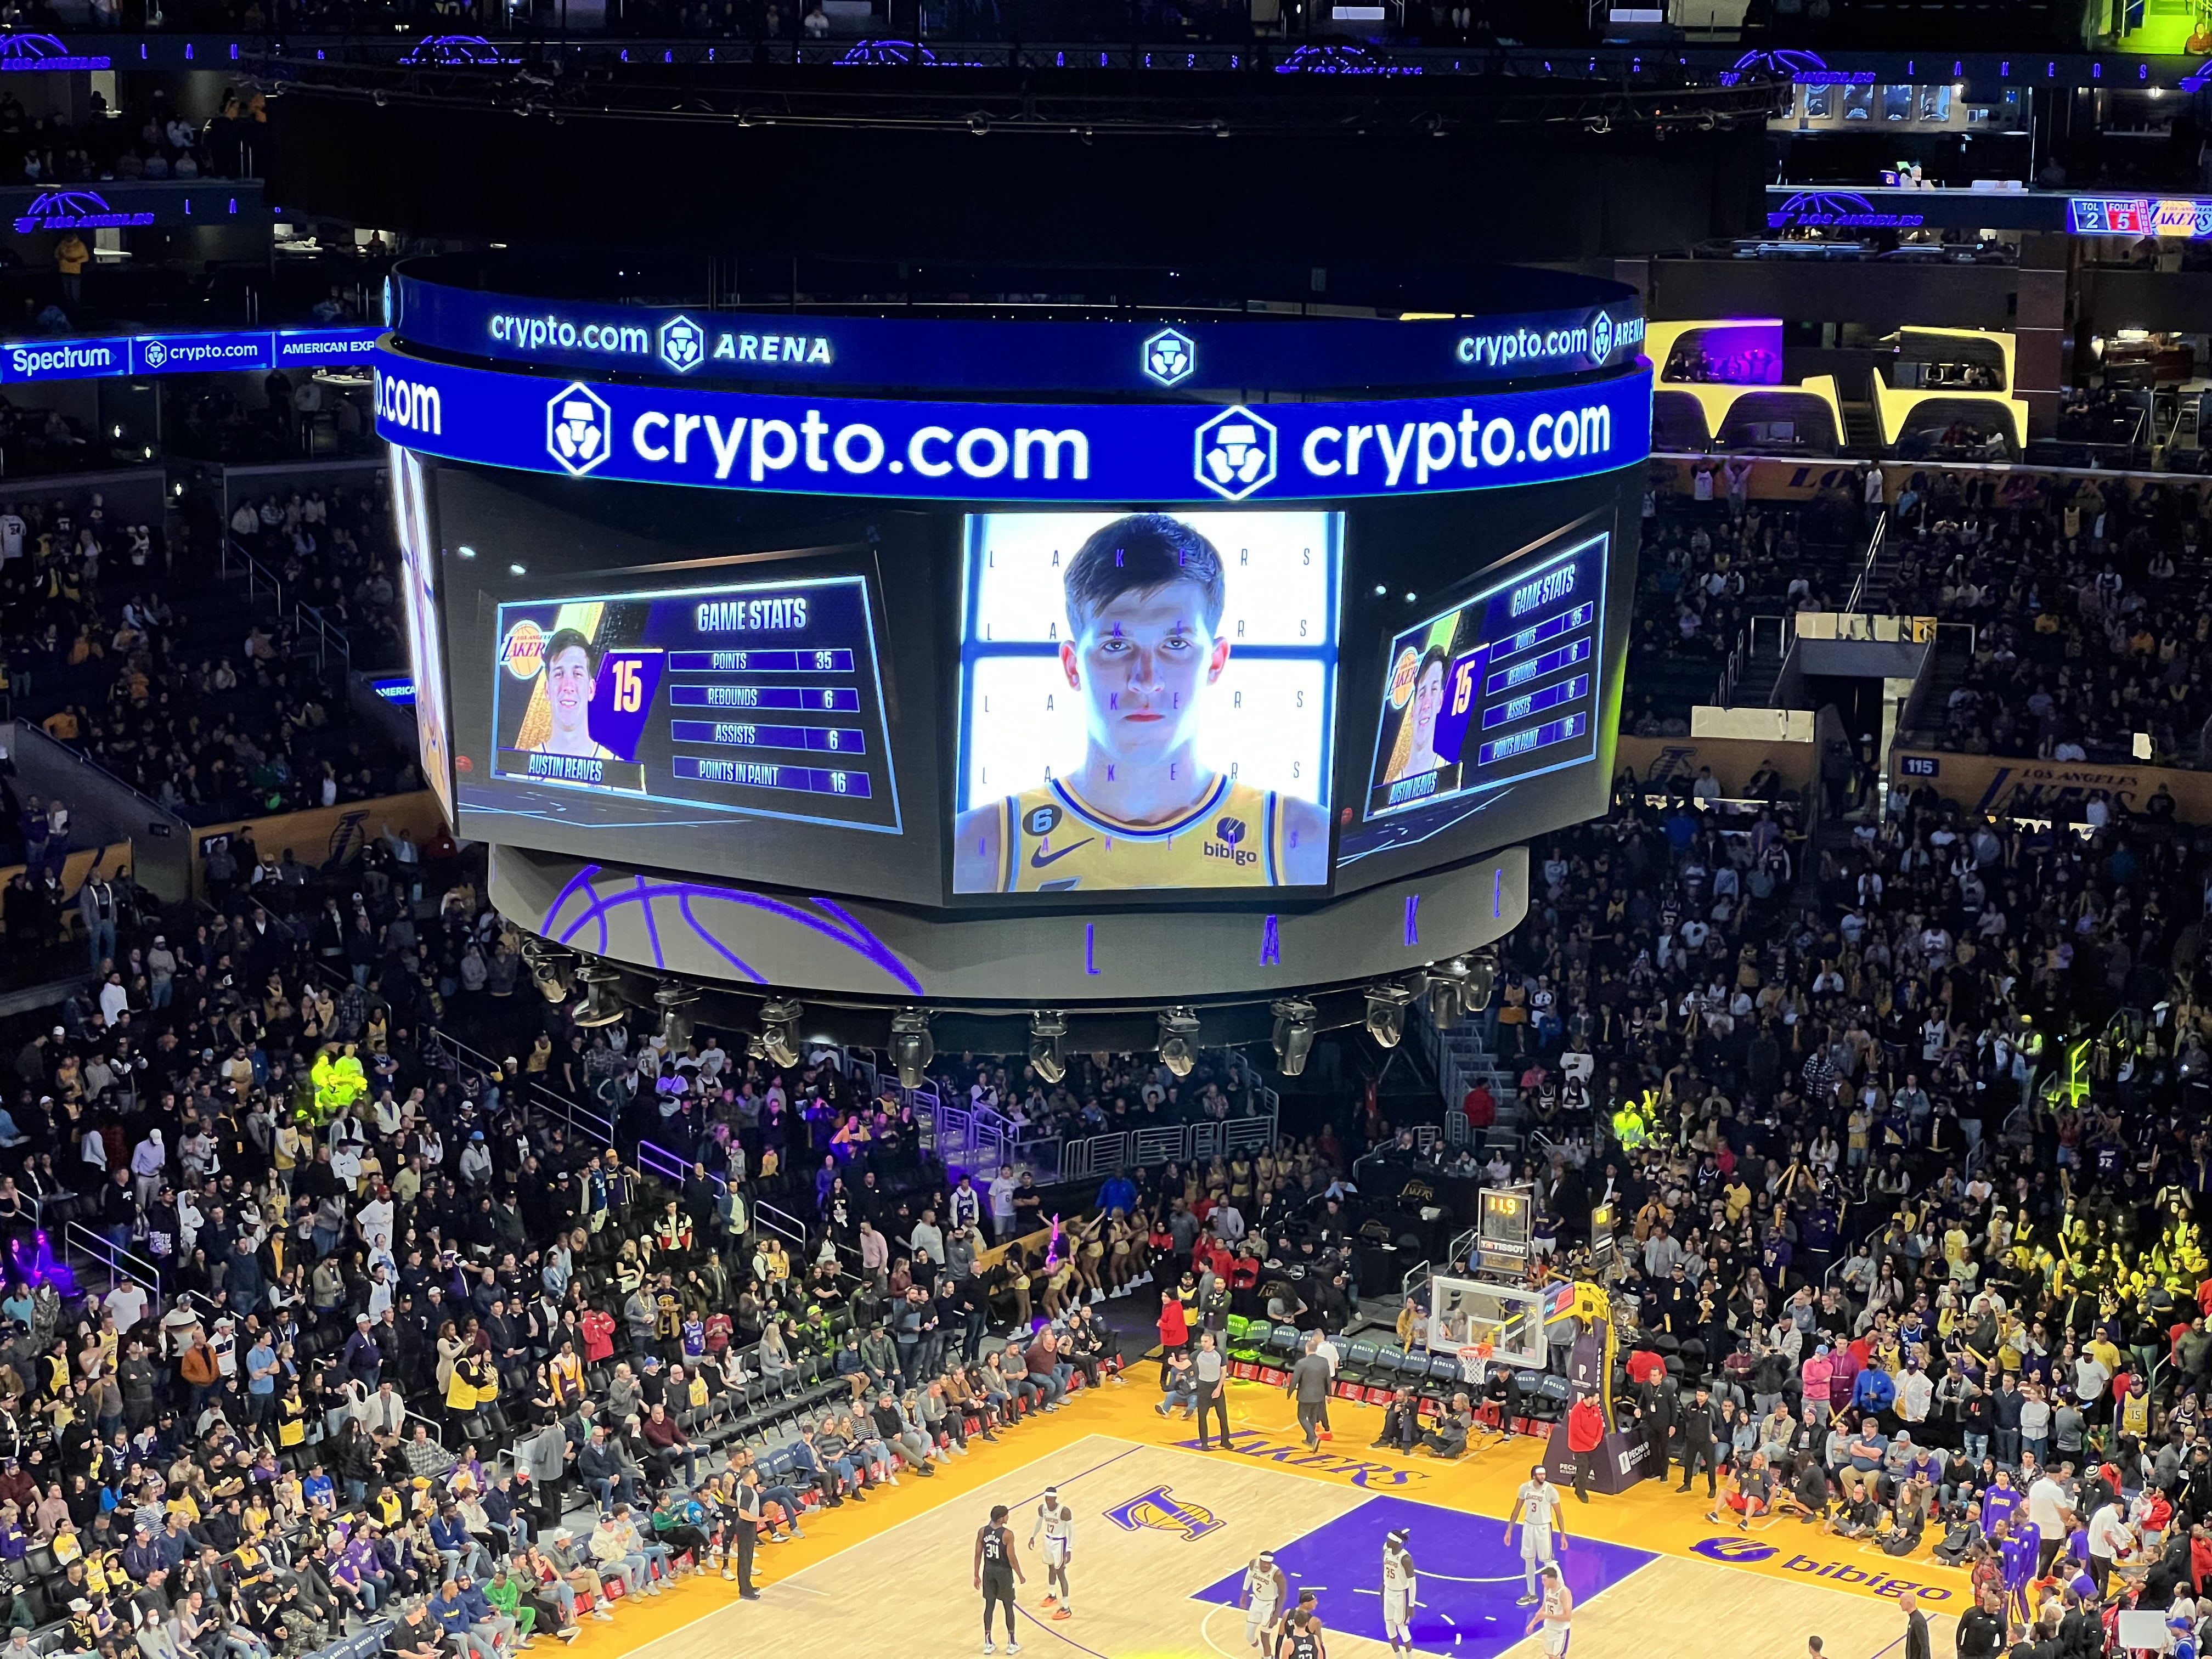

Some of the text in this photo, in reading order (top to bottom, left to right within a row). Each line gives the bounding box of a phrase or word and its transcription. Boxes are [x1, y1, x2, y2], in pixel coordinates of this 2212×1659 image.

[33, 57, 110, 70] ANGELES
[2081, 202, 2099, 211] TOL
[2109, 203, 2135, 212] FOULS
[76, 212, 155, 228] ANGELES
[1797, 214, 1923, 227] LOS ANGELES
[2086, 212, 2098, 229] 2
[2118, 213, 2130, 230] 5
[2149, 206, 2212, 232] LAKERS
[490, 313, 831, 364] crypto.com ARENA
[1459, 317, 1645, 366] crypto.com ARENA
[170, 342, 258, 362] crypto.com
[283, 343, 348, 355] AMERICAN
[13, 346, 111, 376] Spectrum
[633, 409, 1090, 482] crypto.com
[1302, 404, 1611, 487] crypto.com
[1513, 563, 1576, 617] GAME STATS
[698, 597, 807, 631] GAME STATS
[1515, 608, 1583, 651] POINTS 35
[501, 636, 546, 662] LAKER
[1571, 644, 1578, 662] 6
[713, 651, 832, 669] POINTS 35
[612, 660, 643, 713] 15
[1451, 659, 1475, 716] 15
[708, 687, 833, 709] REBOUNDS 6
[1507, 680, 1576, 720] ASSISTS 6
[715, 724, 838, 750] ASSISTS 6
[1493, 737, 1515, 759] POINTS
[1520, 728, 1540, 751] PAINT
[1566, 717, 1575, 737] 16
[528, 754, 603, 782] AUSTIN REAVES
[1907, 759, 1933, 774] 115
[699, 760, 847, 793] POINTS IN PAINT 16
[1411, 770, 1438, 798] REAVES
[2022, 769, 2138, 786] LOS ANGELES
[1032, 808, 1053, 833] 6
[1203, 842, 1257, 866] bibigo
[1490, 1197, 1517, 1215] 11.9
[1493, 1242, 1526, 1254] TISSOT
[1228, 1321, 1244, 1329] DELTA
[1279, 1329, 1295, 1338] DELTA
[1358, 1344, 1374, 1353] DELTA
[1385, 1350, 1401, 1359] DELTA
[1410, 1355, 1427, 1363] DELTA
[1438, 1361, 1455, 1370] DELTA
[1549, 1381, 1566, 1391] DELTA
[2131, 1410, 2141, 1420] 15
[777, 1453, 790, 1464] DELTA
[1158, 1429, 1430, 1491] LAKERS
[676, 1498, 690, 1507] DELTA
[1531, 1502, 1537, 1513] 3
[635, 1517, 650, 1527] DELTA
[1047, 1523, 1054, 1534] 17
[986, 1543, 1000, 1559] 34
[1386, 1567, 1396, 1579] 35
[1781, 1554, 1953, 1600] bibigo
[1256, 1582, 1262, 1593] 2
[358, 1635, 375, 1650] DELTA
[334, 1645, 350, 1658] DELTA
